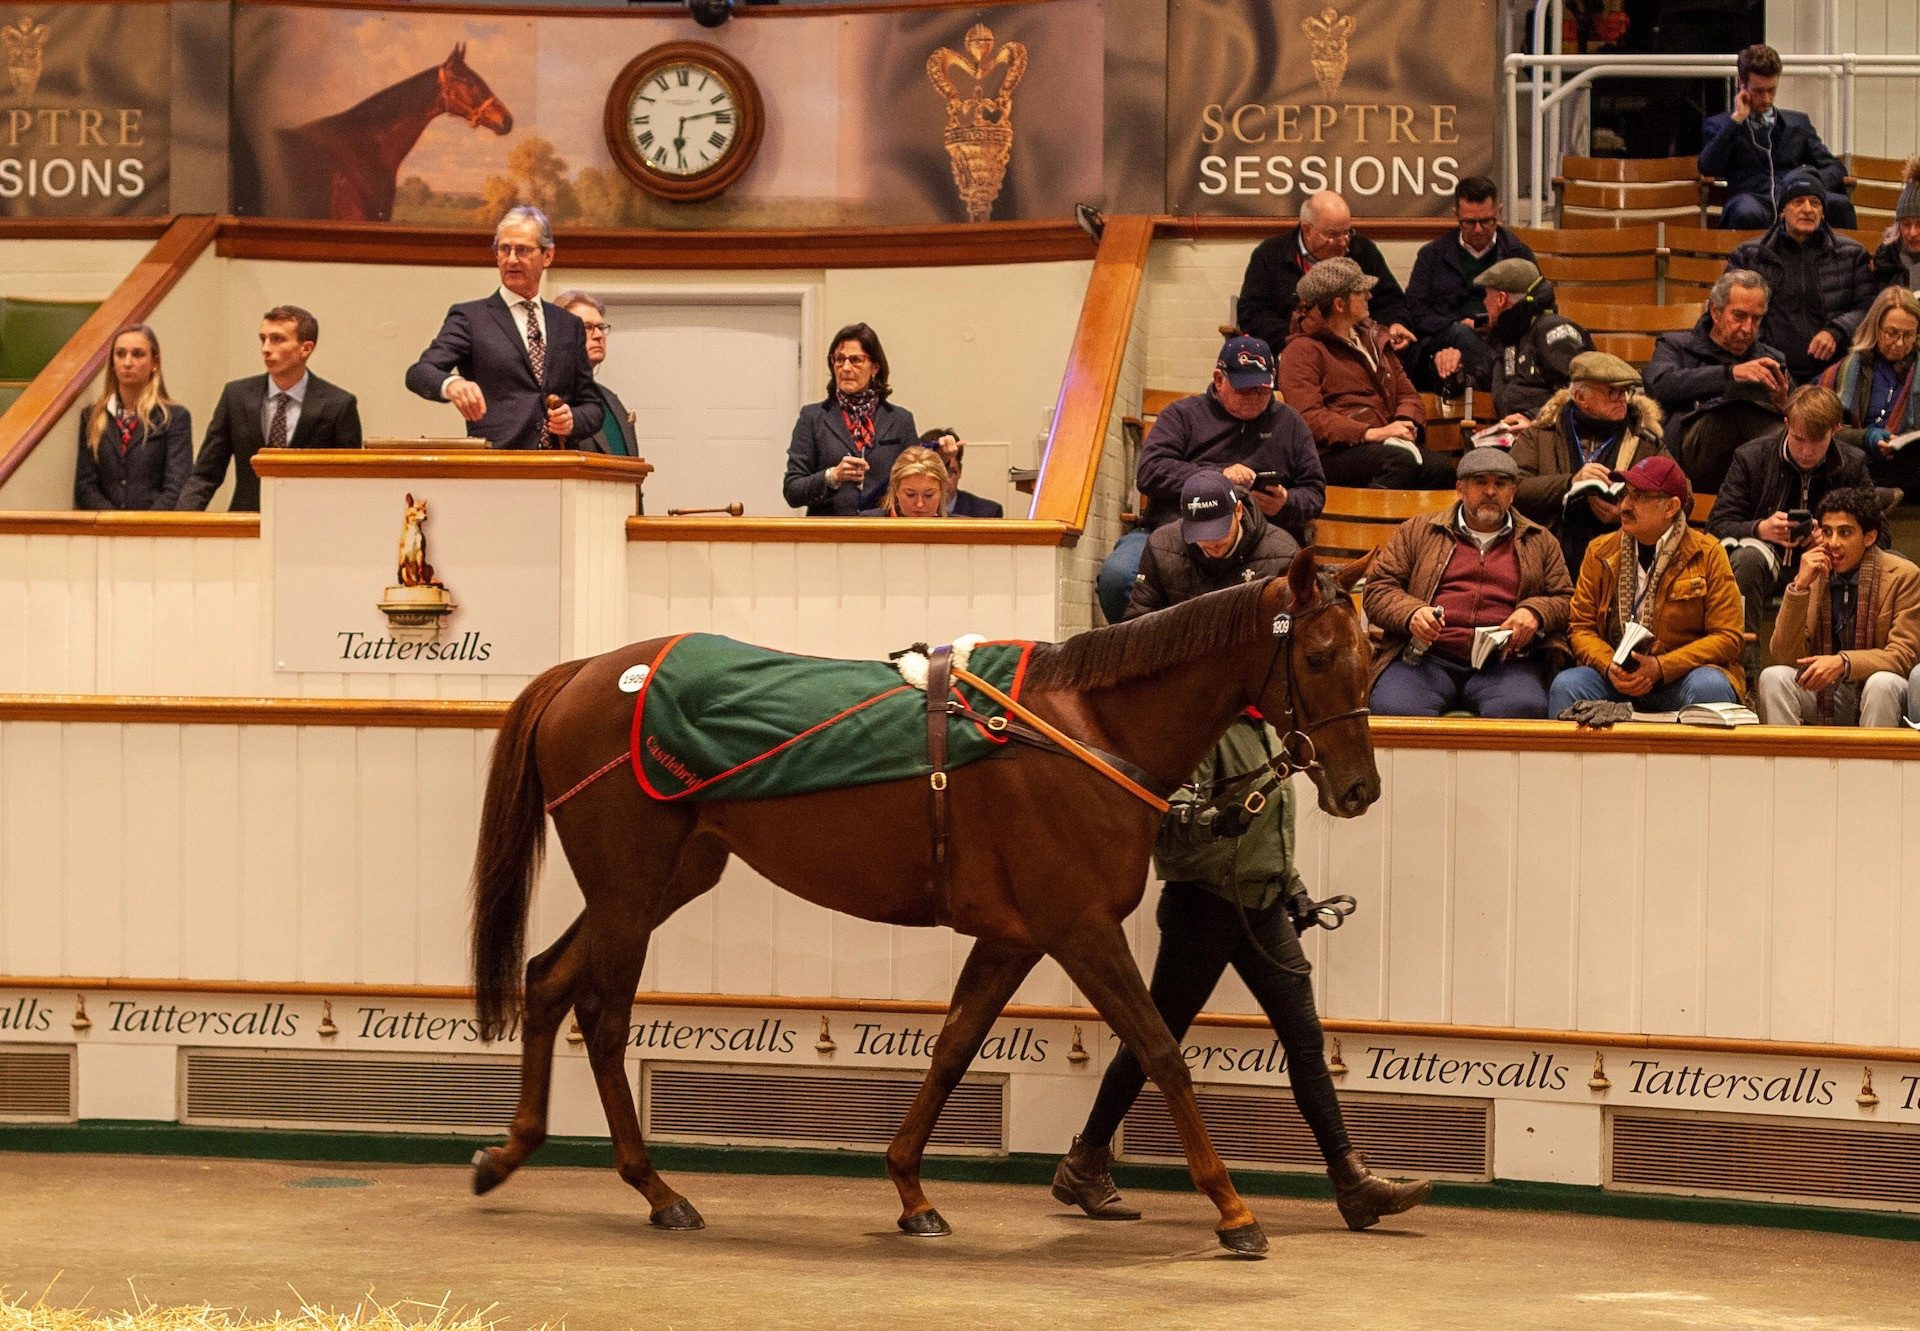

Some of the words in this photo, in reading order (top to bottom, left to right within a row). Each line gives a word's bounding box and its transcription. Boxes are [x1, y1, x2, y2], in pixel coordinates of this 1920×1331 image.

[1202, 104, 1460, 143] SCEPTRE
[1199, 156, 1459, 195] SESSIONS
[1272, 619, 1290, 634] 1909
[337, 631, 492, 661] Tattersalls
[108, 1001, 300, 1037] Tattersalls
[357, 1007, 521, 1045] Tattersal
[627, 1018, 797, 1053] attersalls
[853, 1023, 1049, 1063] Tattealls
[1366, 1046, 1570, 1091] Tattersalls
[1629, 1059, 1836, 1106] Tattersalls
